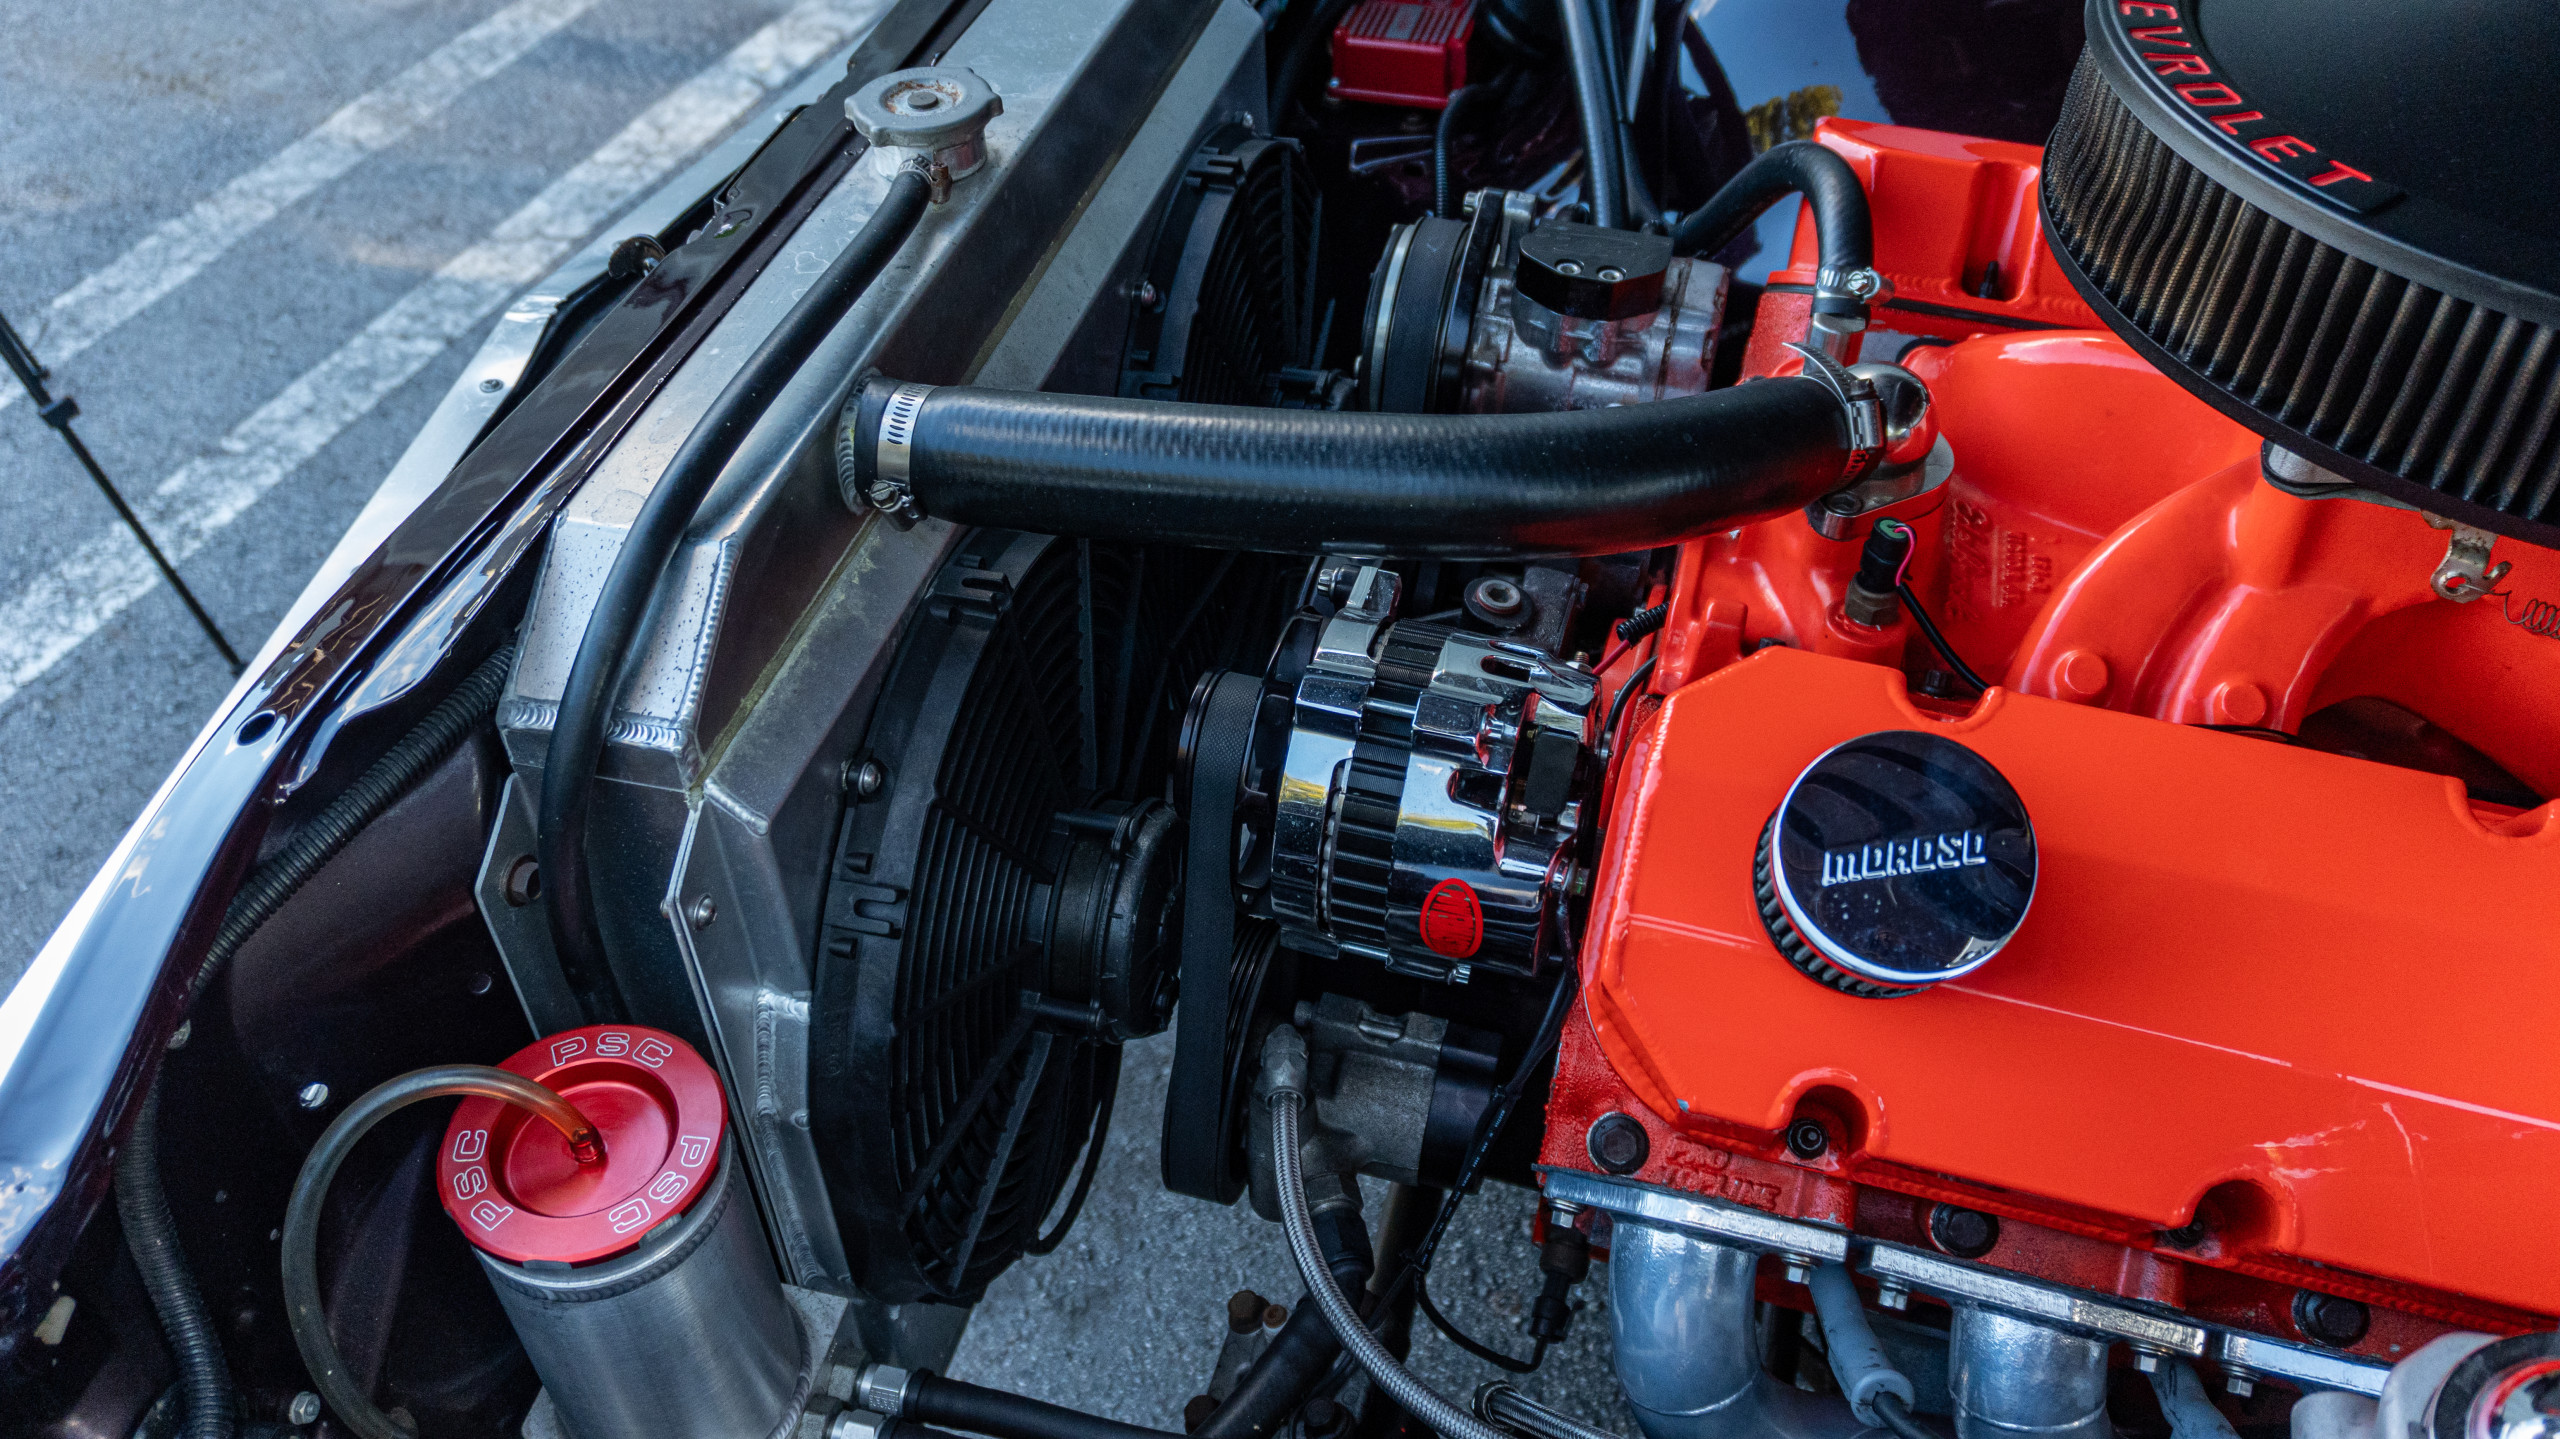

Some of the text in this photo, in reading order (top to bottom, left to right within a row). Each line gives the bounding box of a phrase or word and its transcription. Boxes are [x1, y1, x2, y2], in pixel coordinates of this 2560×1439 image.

[551, 1032, 673, 1068] PSC
[453, 1129, 513, 1231] PSC
[608, 1135, 711, 1233] PSC
